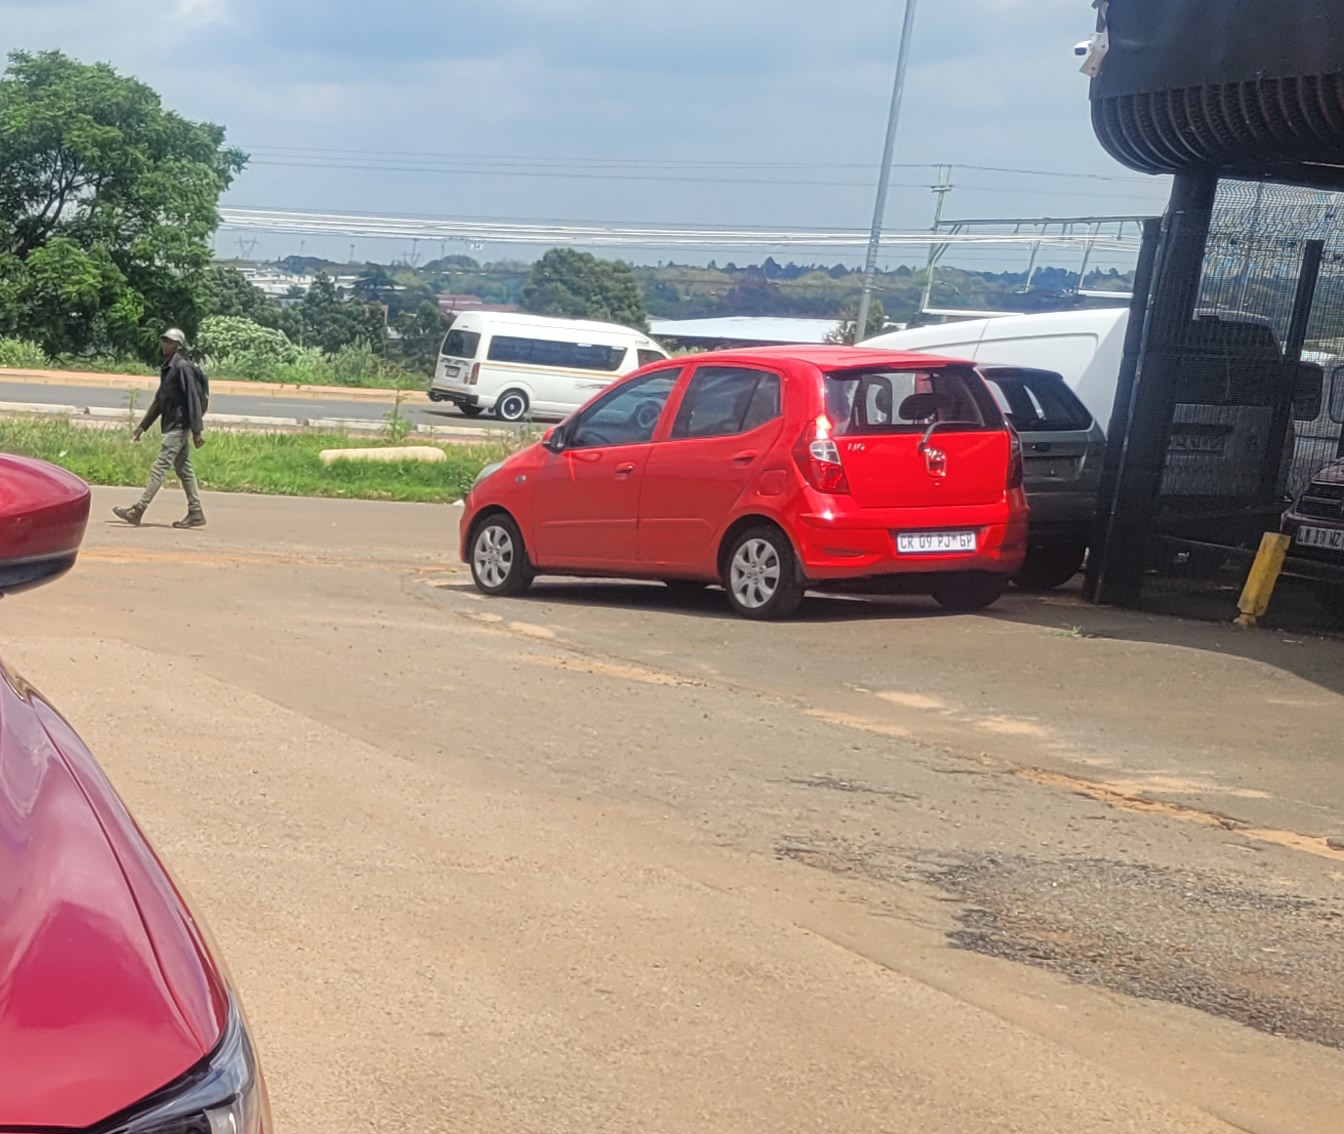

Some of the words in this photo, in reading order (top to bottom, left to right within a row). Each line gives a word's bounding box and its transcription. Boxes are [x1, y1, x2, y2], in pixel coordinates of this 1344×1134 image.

[900, 535, 914, 549] CR
[919, 534, 932, 549] 09
[937, 533, 950, 548] PJ
[959, 533, 972, 547] GP
